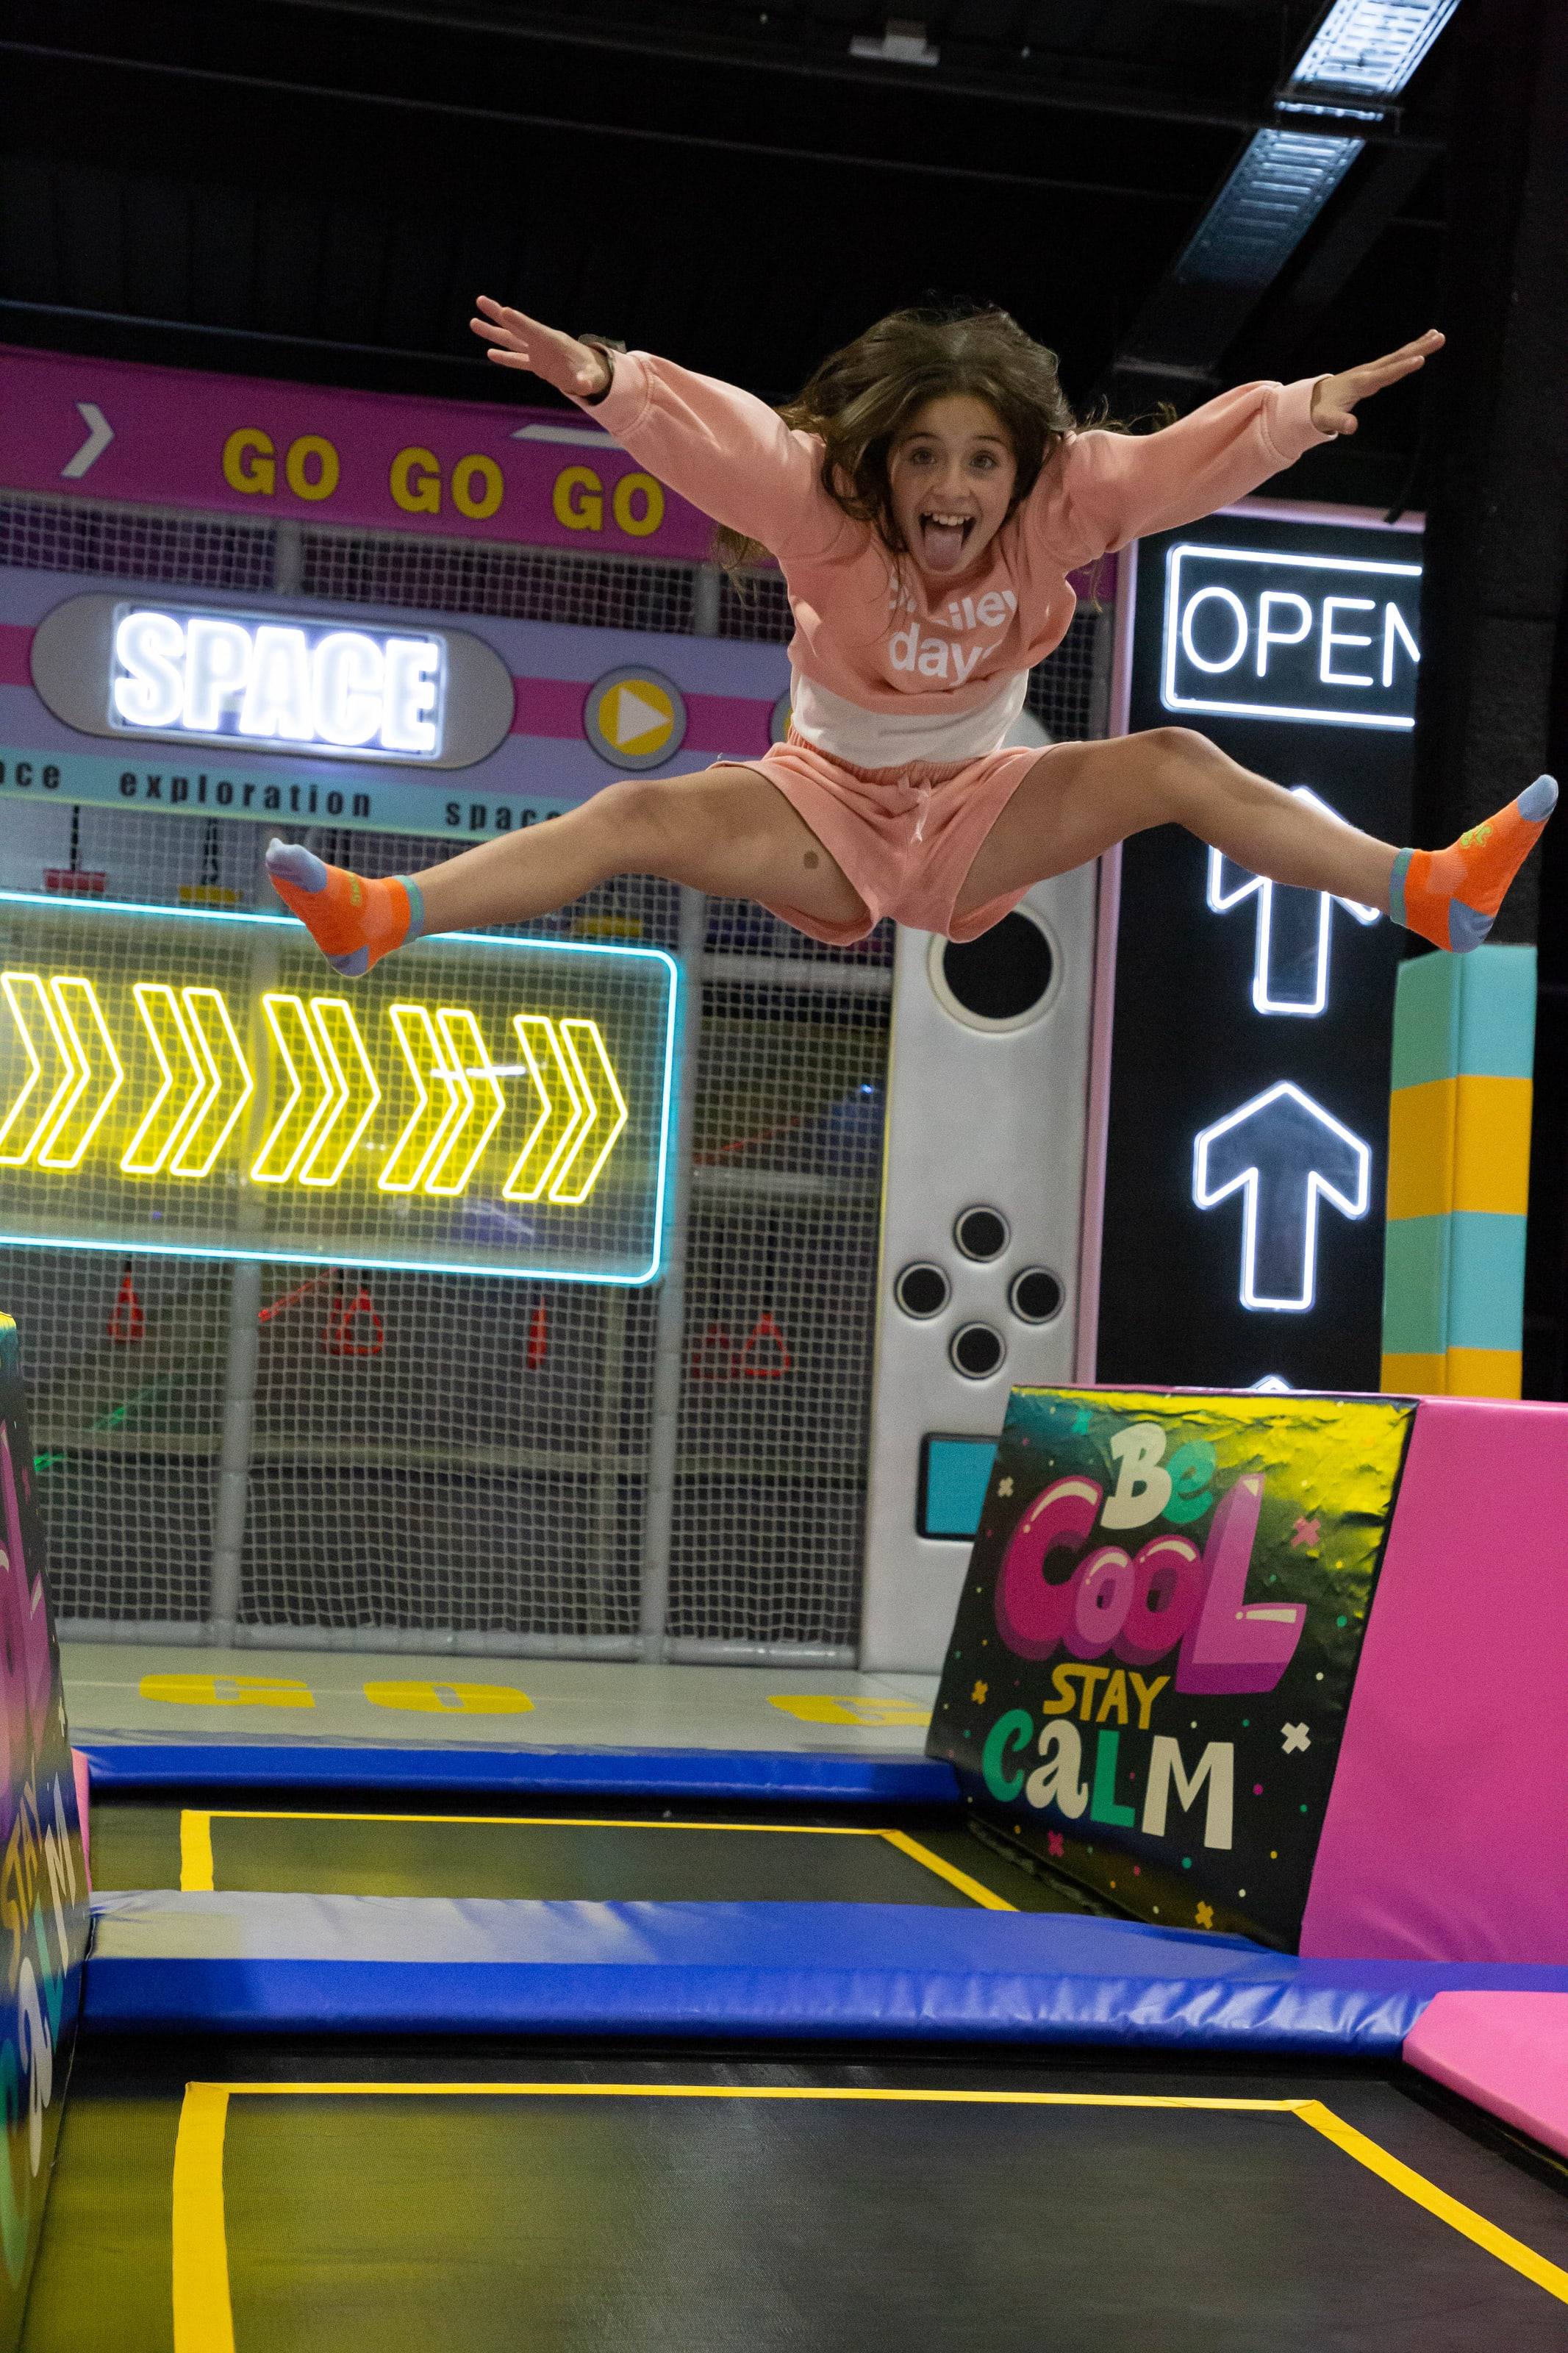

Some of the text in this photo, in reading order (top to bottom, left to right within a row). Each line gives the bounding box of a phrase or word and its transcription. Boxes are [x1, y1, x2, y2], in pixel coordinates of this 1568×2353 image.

[223, 427, 666, 538] GO GO GO
[113, 611, 440, 753] SPACE
[119, 772, 371, 819] exploration
[445, 801, 563, 832] spac
[1100, 1421, 1216, 1530] Be
[1043, 1663, 1171, 1730] STAY
